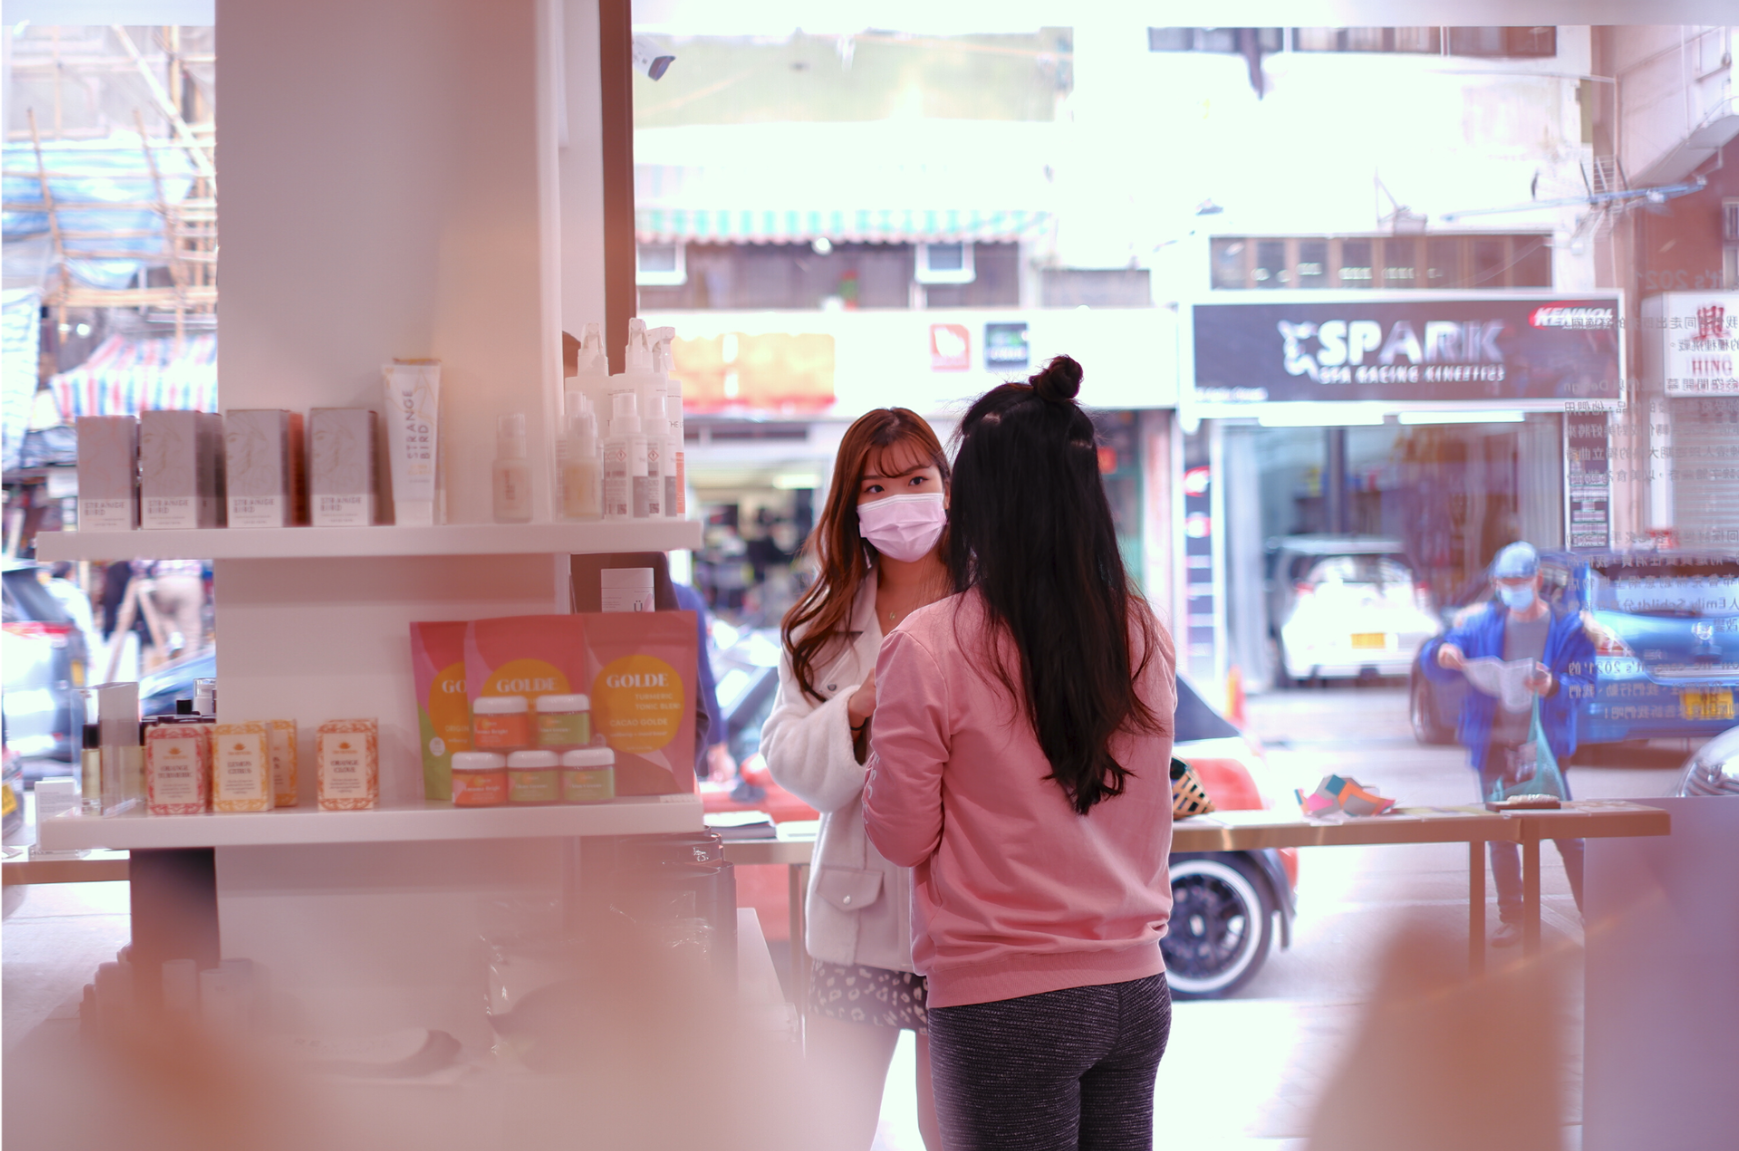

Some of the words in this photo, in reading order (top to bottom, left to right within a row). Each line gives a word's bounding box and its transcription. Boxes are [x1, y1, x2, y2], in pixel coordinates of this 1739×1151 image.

[1317, 318, 1505, 365] SPARK
[1691, 356, 1733, 376] HING
[402, 390, 419, 459] STRANGE
[418, 424, 431, 459] BIRD
[441, 680, 467, 694] GO
[496, 677, 559, 693] GOLDE
[605, 673, 669, 688] GOLDE
[635, 693, 673, 701] TURMERIC
[610, 719, 639, 727] CACAO
[640, 718, 668, 726] GOLDE
